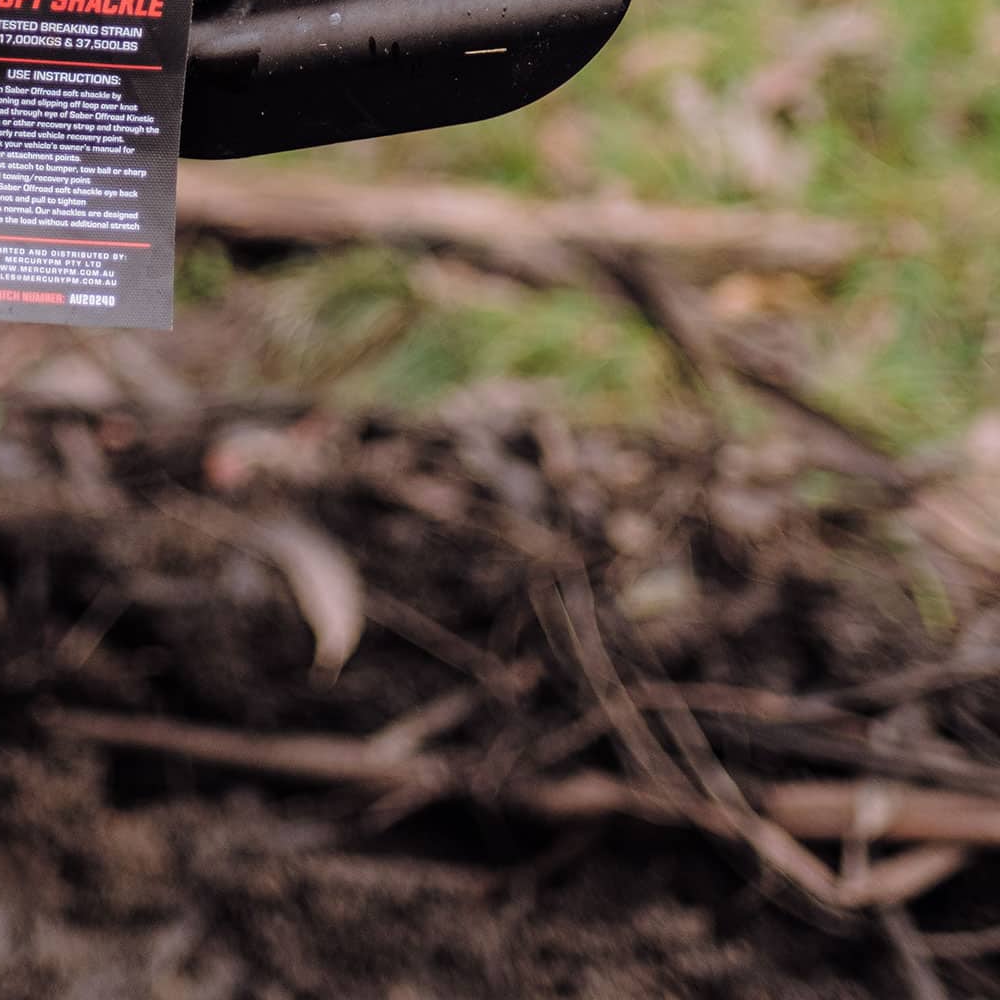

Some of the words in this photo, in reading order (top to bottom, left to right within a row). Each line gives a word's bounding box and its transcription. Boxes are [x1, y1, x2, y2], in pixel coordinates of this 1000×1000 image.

[40, 22, 98, 34] BREAKING
[101, 25, 142, 37] STRAIN
[65, 37, 73, 48] &
[76, 38, 138, 52] 37,500LBS
[8, 69, 30, 80] USE
[33, 70, 121, 85] INSTRUCTIONS:
[5, 85, 28, 94] Saber
[30, 87, 61, 96] Offroad
[62, 88, 79, 97] soft
[80, 89, 110, 98] shackle
[111, 91, 121, 101] by
[38, 98, 67, 108] slipping
[82, 101, 98, 110] loop
[120, 103, 138, 111] knot
[11, 107, 42, 118] through
[44, 111, 58, 119] eye
[70, 111, 94, 119] Saber
[95, 112, 124, 121] Offroad
[126, 114, 154, 122] Kinetic
[13, 118, 35, 127] other
[37, 121, 71, 130] recovery
[73, 122, 95, 131] strap
[96, 123, 111, 131] and
[113, 124, 144, 134] through
[146, 126, 159, 134] the
[14, 129, 36, 137] rated
[38, 131, 64, 139] vehicle
[67, 133, 101, 143] recovery
[102, 134, 124, 144] point.
[4, 141, 22, 149] your
[92, 144, 121, 153] manual
[122, 146, 135, 154] for
[7, 151, 53, 160] attachment
[7, 161, 33, 170] attach
[46, 163, 78, 174] bumper,
[80, 165, 95, 173] tow
[97, 166, 111, 174] ball
[123, 168, 147, 178] sharp
[70, 176, 90, 185] point
[23, 184, 53, 192] Offroad
[72, 187, 102, 195] shackle
[104, 190, 117, 198] eye
[120, 189, 138, 197] back
[15, 194, 29, 202] and
[31, 195, 45, 205] pull
[47, 196, 56, 204] to
[58, 197, 86, 207] tighten
[4, 204, 33, 213] normal.
[35, 206, 50, 214] Our
[52, 207, 86, 216] shackles
[103, 210, 138, 221] designed
[5, 215, 18, 223] the
[20, 216, 36, 224] load
[38, 217, 68, 226] without
[70, 219, 109, 228] additional
[111, 221, 139, 230] stretch
[5, 256, 61, 265] MERCURYPM
[28, 248, 47, 256] AND
[51, 250, 109, 259] DISTRIBUTED
[69, 293, 115, 307] AU20240
